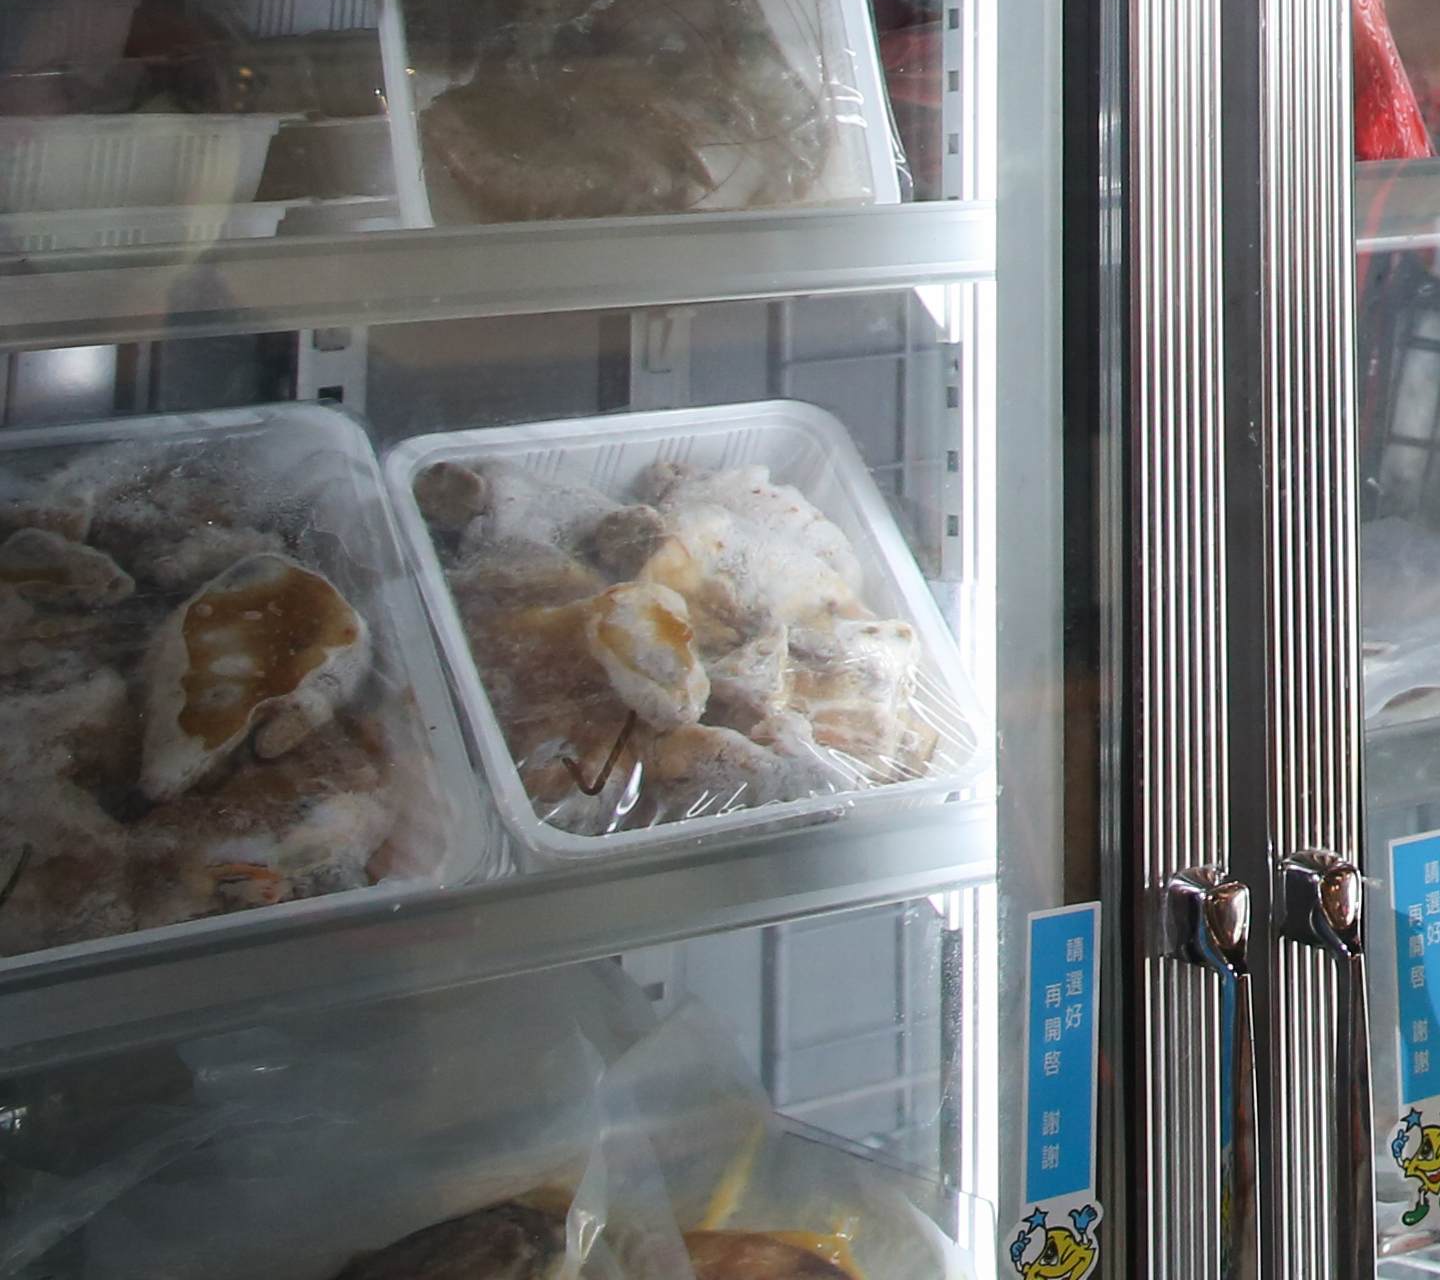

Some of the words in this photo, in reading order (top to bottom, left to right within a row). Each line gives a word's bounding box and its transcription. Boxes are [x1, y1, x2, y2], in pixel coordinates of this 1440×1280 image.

[1065, 936, 1085, 1030] 請選好
[1412, 1019, 1430, 1074] 謝謝
[1041, 1108, 1061, 1171] 謝謝
